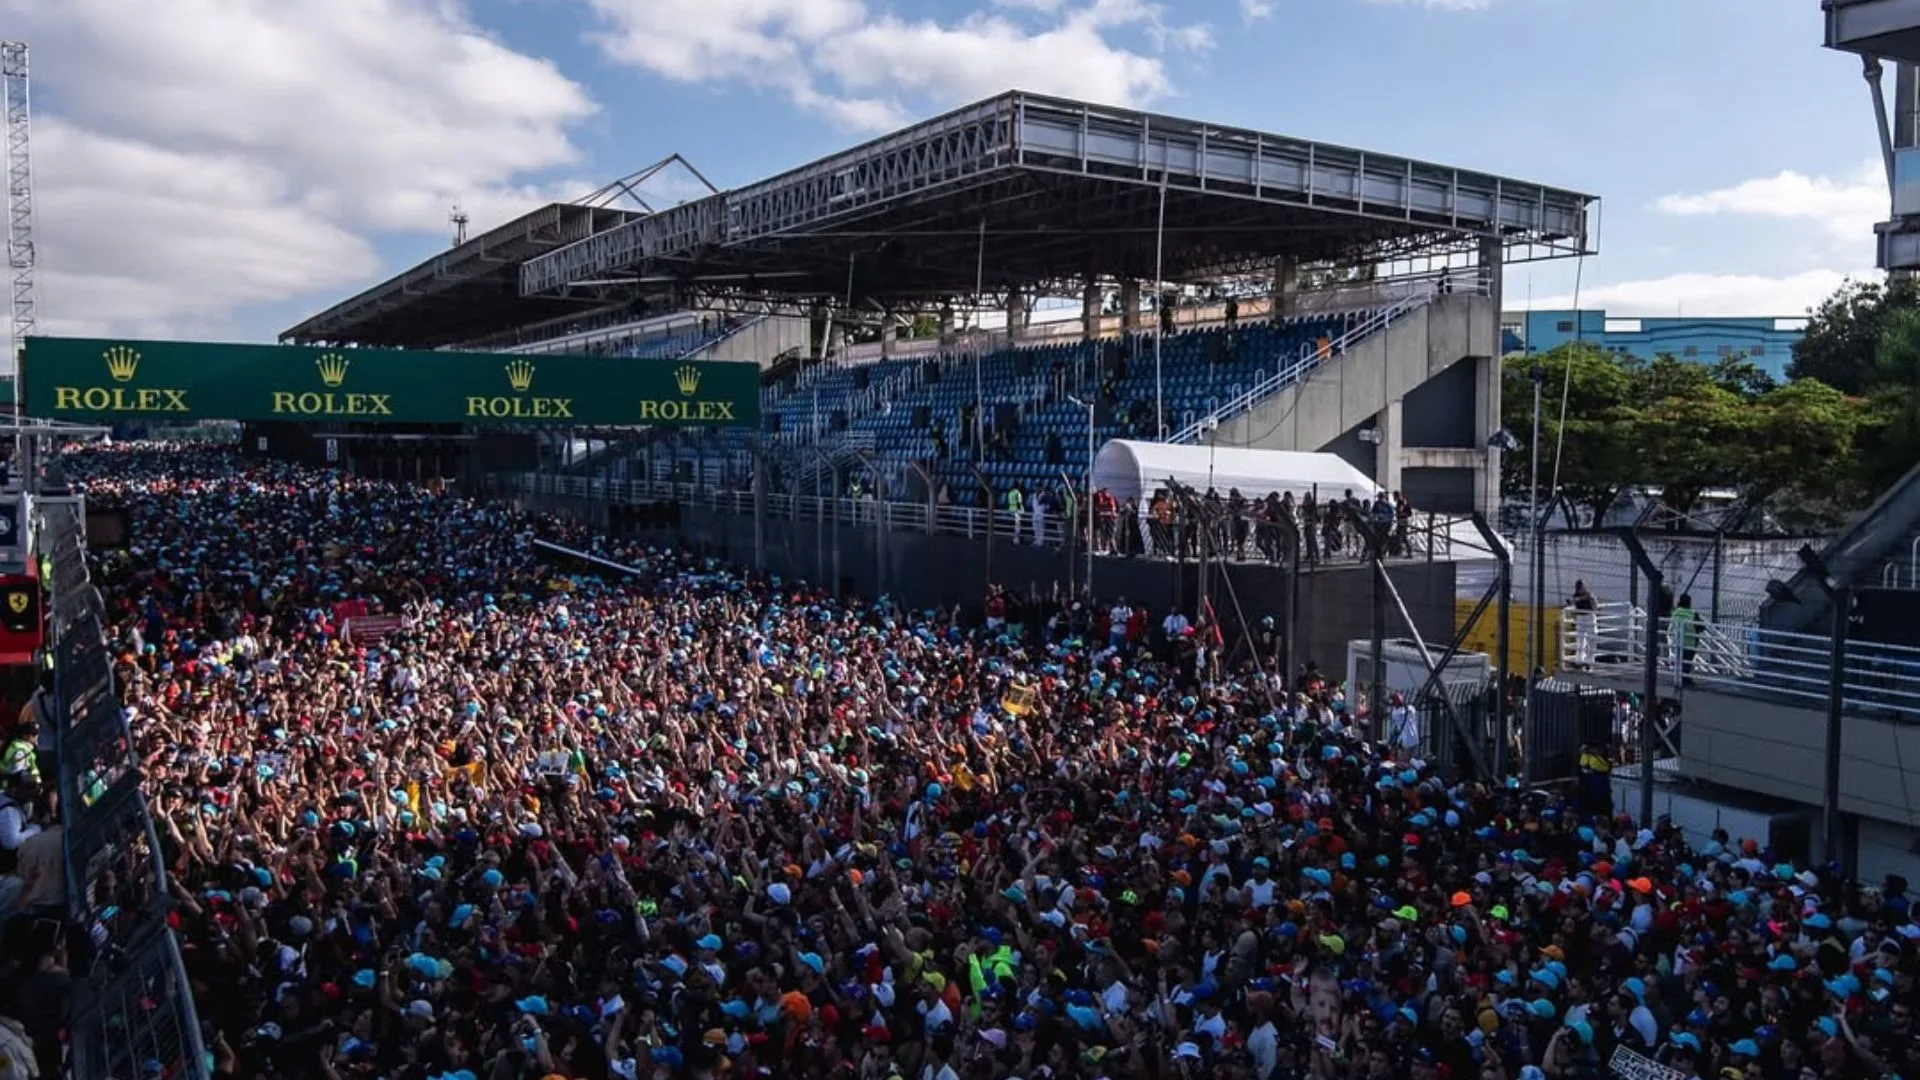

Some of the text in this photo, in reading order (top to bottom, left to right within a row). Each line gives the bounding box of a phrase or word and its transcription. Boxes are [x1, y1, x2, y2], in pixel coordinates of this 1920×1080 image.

[55, 387, 190, 411] ROLEX
[273, 392, 392, 415] ROLEX
[467, 397, 573, 418] ROLEX
[640, 400, 735, 420] ROLEX
